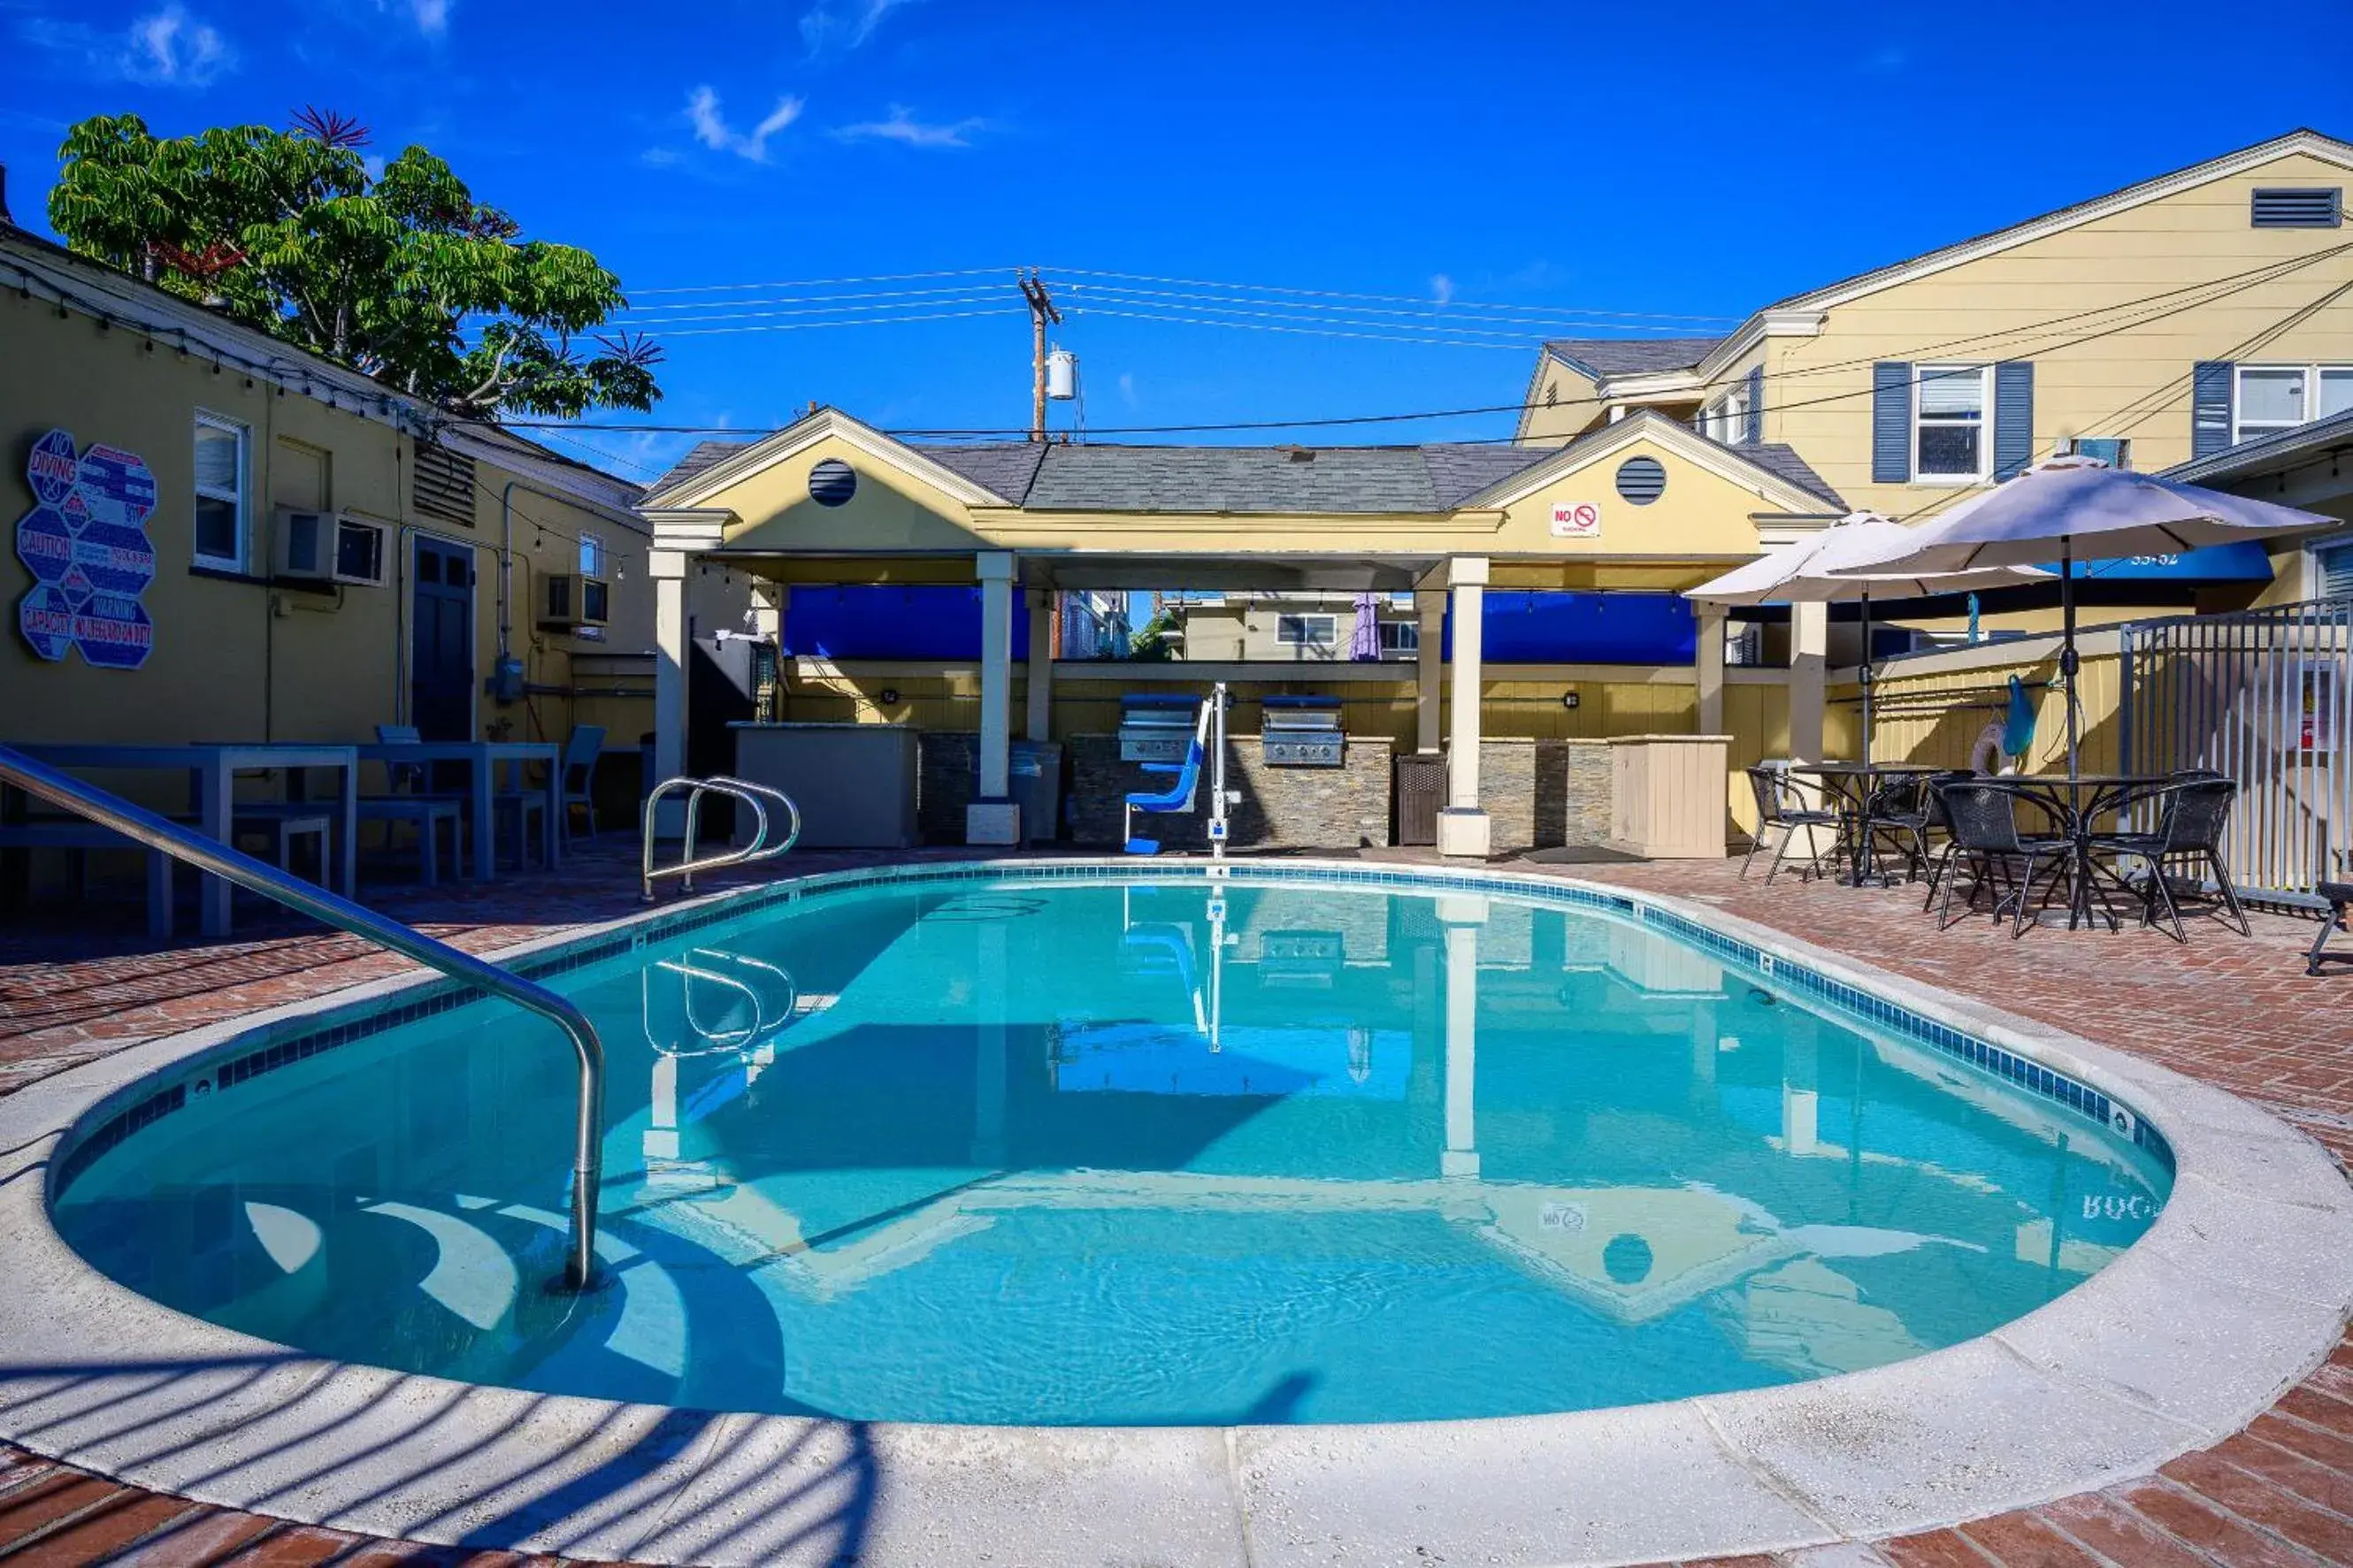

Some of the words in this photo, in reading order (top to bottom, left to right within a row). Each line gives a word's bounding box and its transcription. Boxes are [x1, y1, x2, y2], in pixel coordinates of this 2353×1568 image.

[50, 434, 70, 456] NO
[30, 451, 76, 482] DIVING
[1555, 510, 1571, 522] NO
[20, 531, 71, 560] CAUTION
[93, 595, 136, 622] WARNING
[26, 609, 71, 638] CAPACITY
